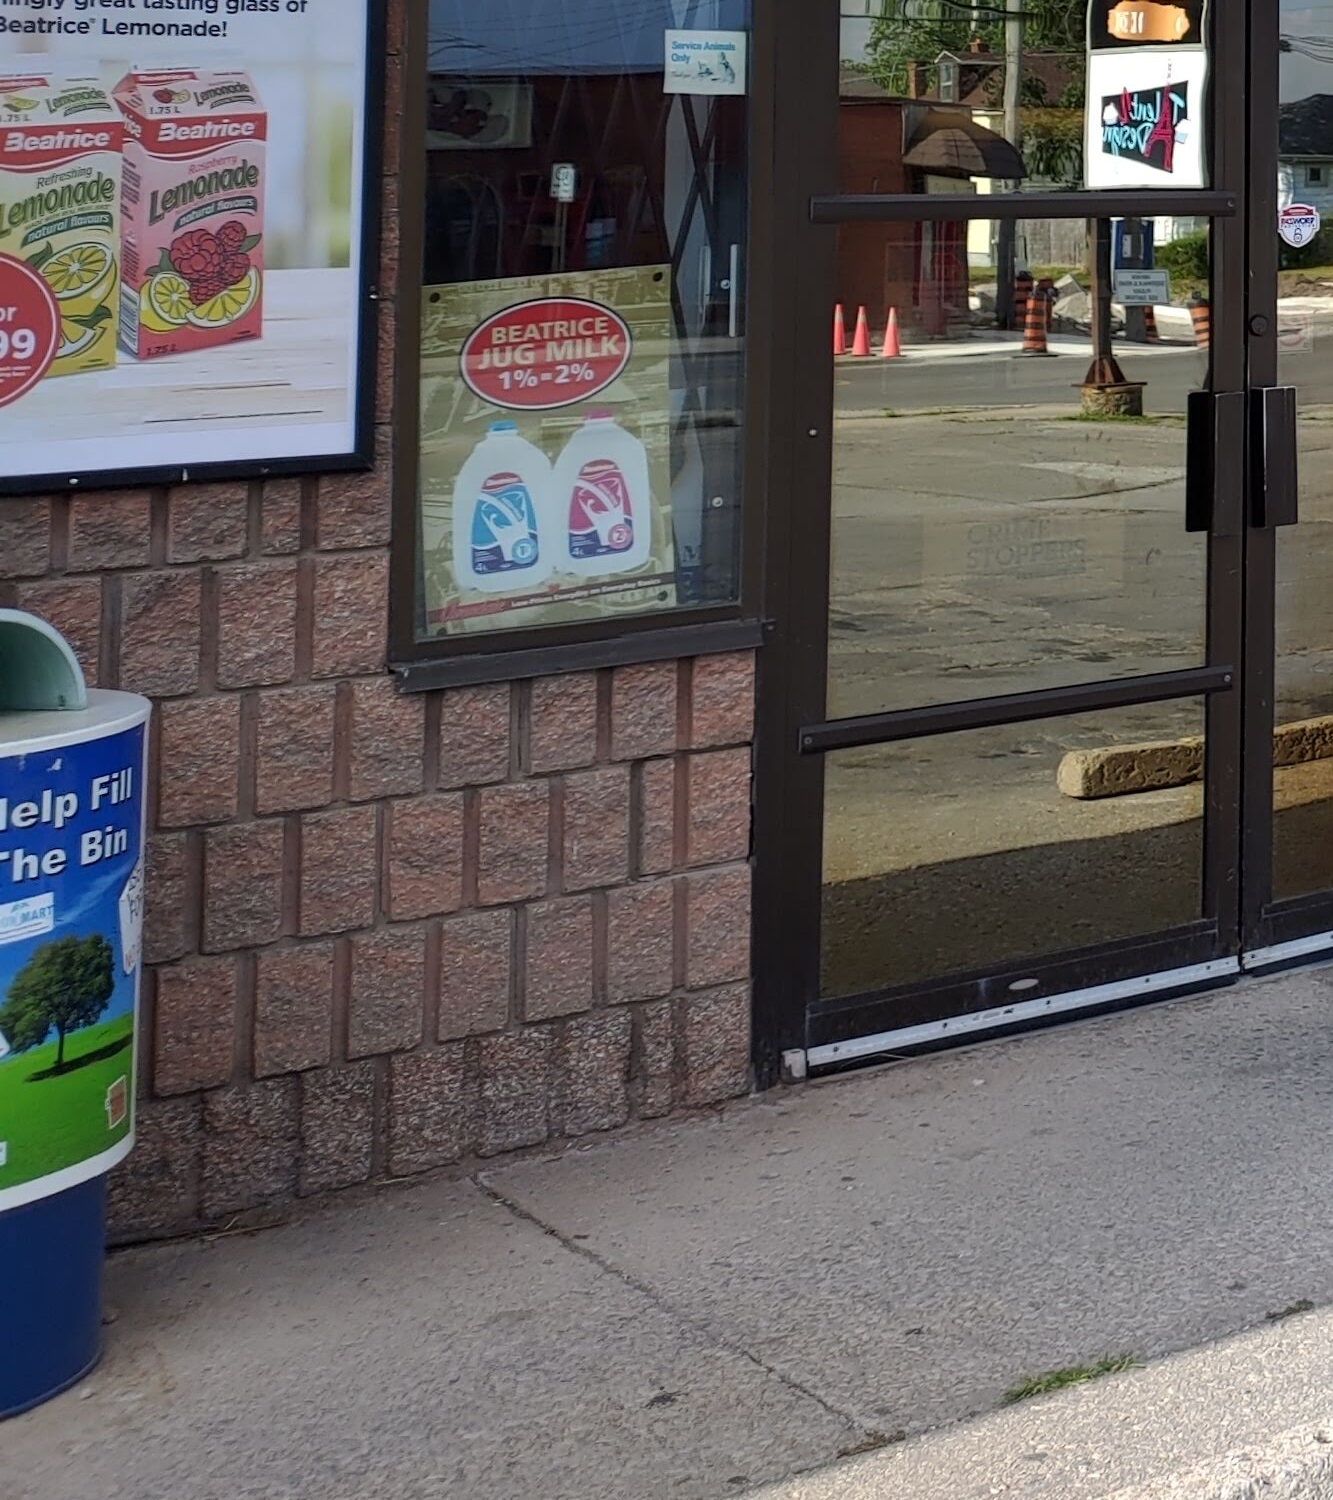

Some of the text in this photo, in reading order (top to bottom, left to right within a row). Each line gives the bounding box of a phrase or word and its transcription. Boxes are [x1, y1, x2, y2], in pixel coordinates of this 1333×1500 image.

[102, 18, 227, 37] Lemonade!
[671, 41, 736, 51] Service Animals
[671, 53, 691, 64] Only
[5, 130, 110, 150] Beatrice
[157, 119, 256, 141] Beatrice
[188, 156, 237, 174] Raspberry
[36, 167, 93, 189] Refreshing
[149, 159, 259, 226] Lemonade
[180, 198, 254, 225] natural flavours
[28, 219, 68, 241] natural
[70, 214, 109, 227] flavours
[491, 317, 609, 344] BEATRICE
[478, 335, 621, 370] JUG MILK
[91, 767, 132, 811] Fill
[80, 825, 127, 866] Bin
